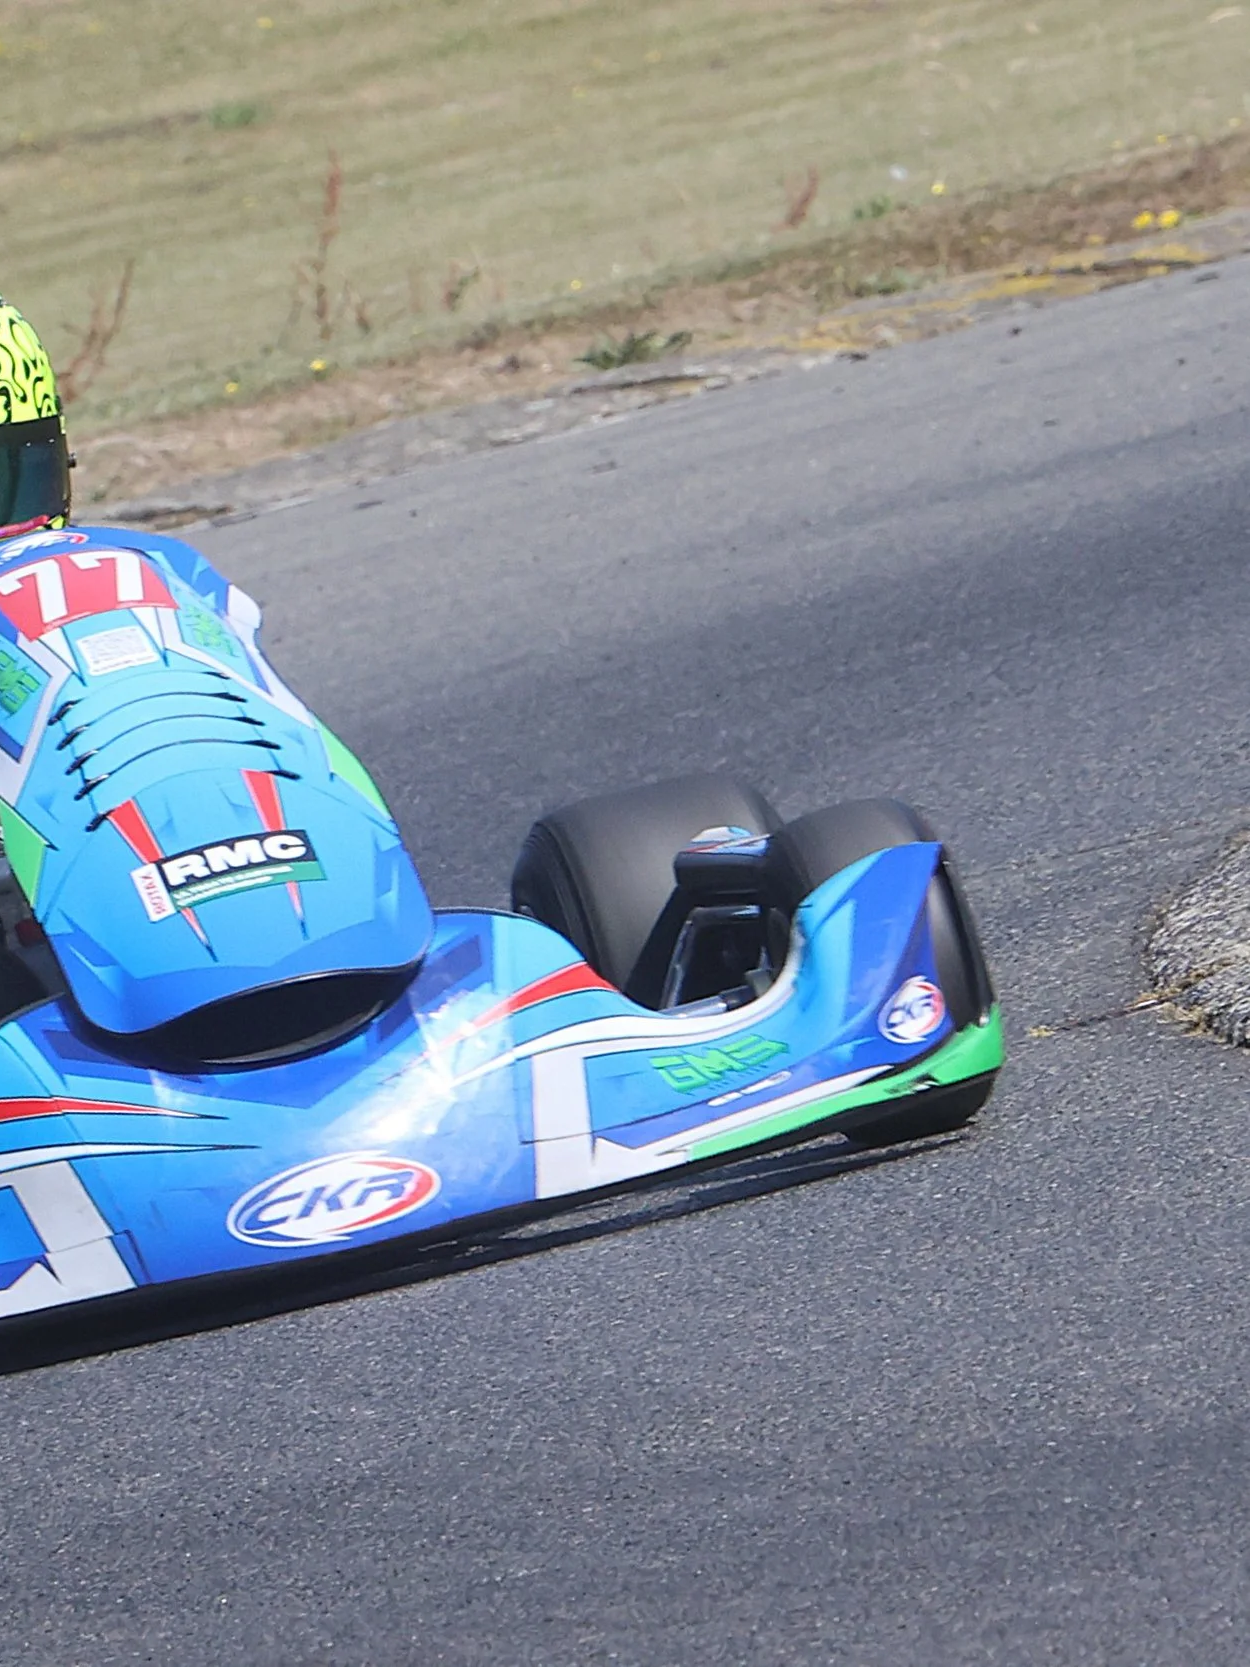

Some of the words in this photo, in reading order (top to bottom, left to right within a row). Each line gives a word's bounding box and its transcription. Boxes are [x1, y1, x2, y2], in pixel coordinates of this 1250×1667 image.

[161, 834, 307, 886] RMC
[650, 1034, 789, 1093] GMS
[243, 1170, 415, 1231] CKR
